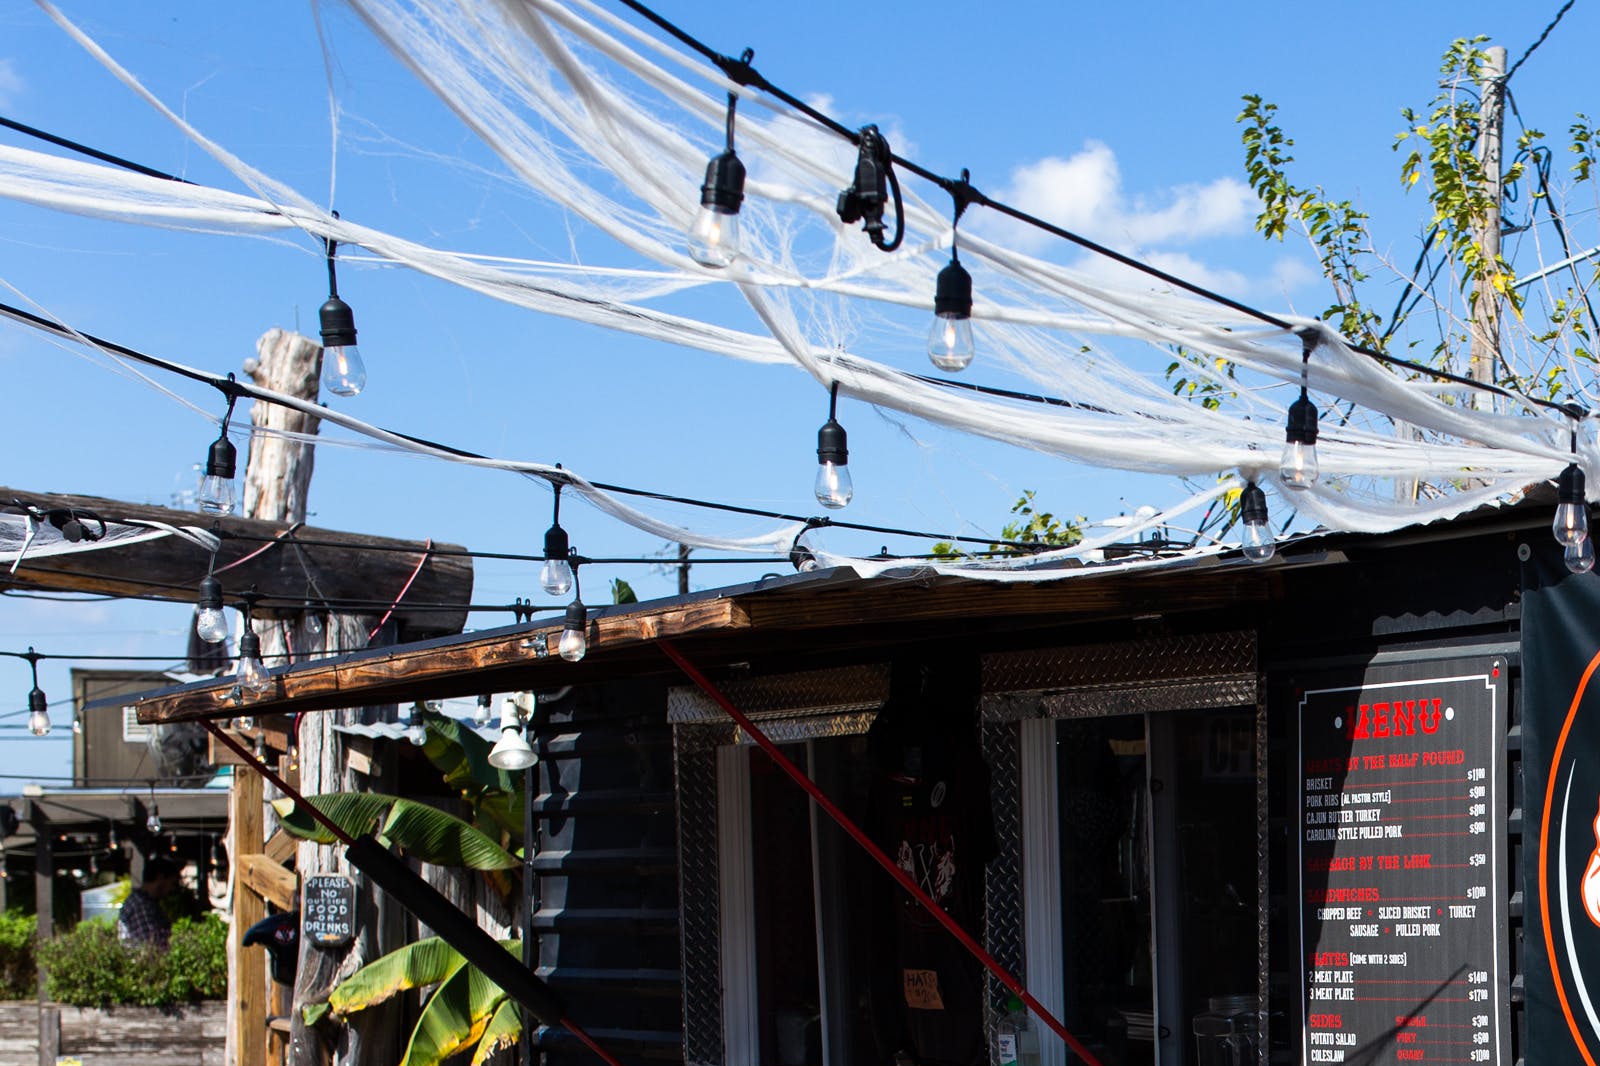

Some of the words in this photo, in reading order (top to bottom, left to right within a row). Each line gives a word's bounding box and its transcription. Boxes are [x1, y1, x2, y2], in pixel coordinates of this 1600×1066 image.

[1346, 698, 1442, 740] MENU
[1347, 757, 1359, 771] BY
[1363, 755, 1384, 770] THE
[1389, 752, 1419, 768] HALF
[1423, 750, 1465, 766] POUND
[1306, 777, 1333, 791] BRISKET
[1306, 795, 1323, 807] PORK
[1324, 794, 1339, 806] RIBS
[1351, 792, 1371, 804] PASTOR
[1306, 812, 1327, 825] CAJUN
[1328, 810, 1353, 823] BUTTER
[1354, 809, 1381, 822] TURKEY
[1306, 828, 1336, 841] CAROLINA
[1337, 826, 1358, 840] STYLE
[1359, 825, 1383, 839] PULLED
[1384, 825, 1403, 838] PORK
[1307, 856, 1355, 871] SAUSAGE
[1359, 857, 1373, 870] BY
[1377, 855, 1400, 869] THE
[1403, 854, 1433, 869] LINK
[312, 878, 346, 888] PLEASE
[321, 889, 337, 898] NO
[1307, 888, 1380, 903] SANDWICHES
[308, 905, 347, 914] FOOD
[1317, 908, 1345, 921] CHOPPED
[1346, 907, 1362, 920] BEEF
[1378, 906, 1401, 919] SLICED
[1402, 905, 1431, 919] BRISKET
[1449, 905, 1476, 918] TURKEY
[305, 922, 349, 934] DRINKS
[1350, 924, 1379, 937] SAUSAGE
[1395, 924, 1420, 937] PULLED
[1422, 923, 1440, 936] PORK
[1309, 952, 1349, 967] PLATES
[1368, 954, 1384, 965] WITH
[1309, 971, 1313, 982] 2
[1314, 971, 1333, 983] MEAT
[1333, 971, 1354, 983] PLATE
[1309, 988, 1314, 1000] 3
[1315, 988, 1333, 1000] MEAT
[1334, 988, 1355, 1000] PLATE
[1309, 1014, 1342, 1029] SIDES
[1311, 1033, 1334, 1045] POTATO
[1335, 1033, 1357, 1046] SALAD
[1311, 1049, 1344, 1062] COLESLAW
